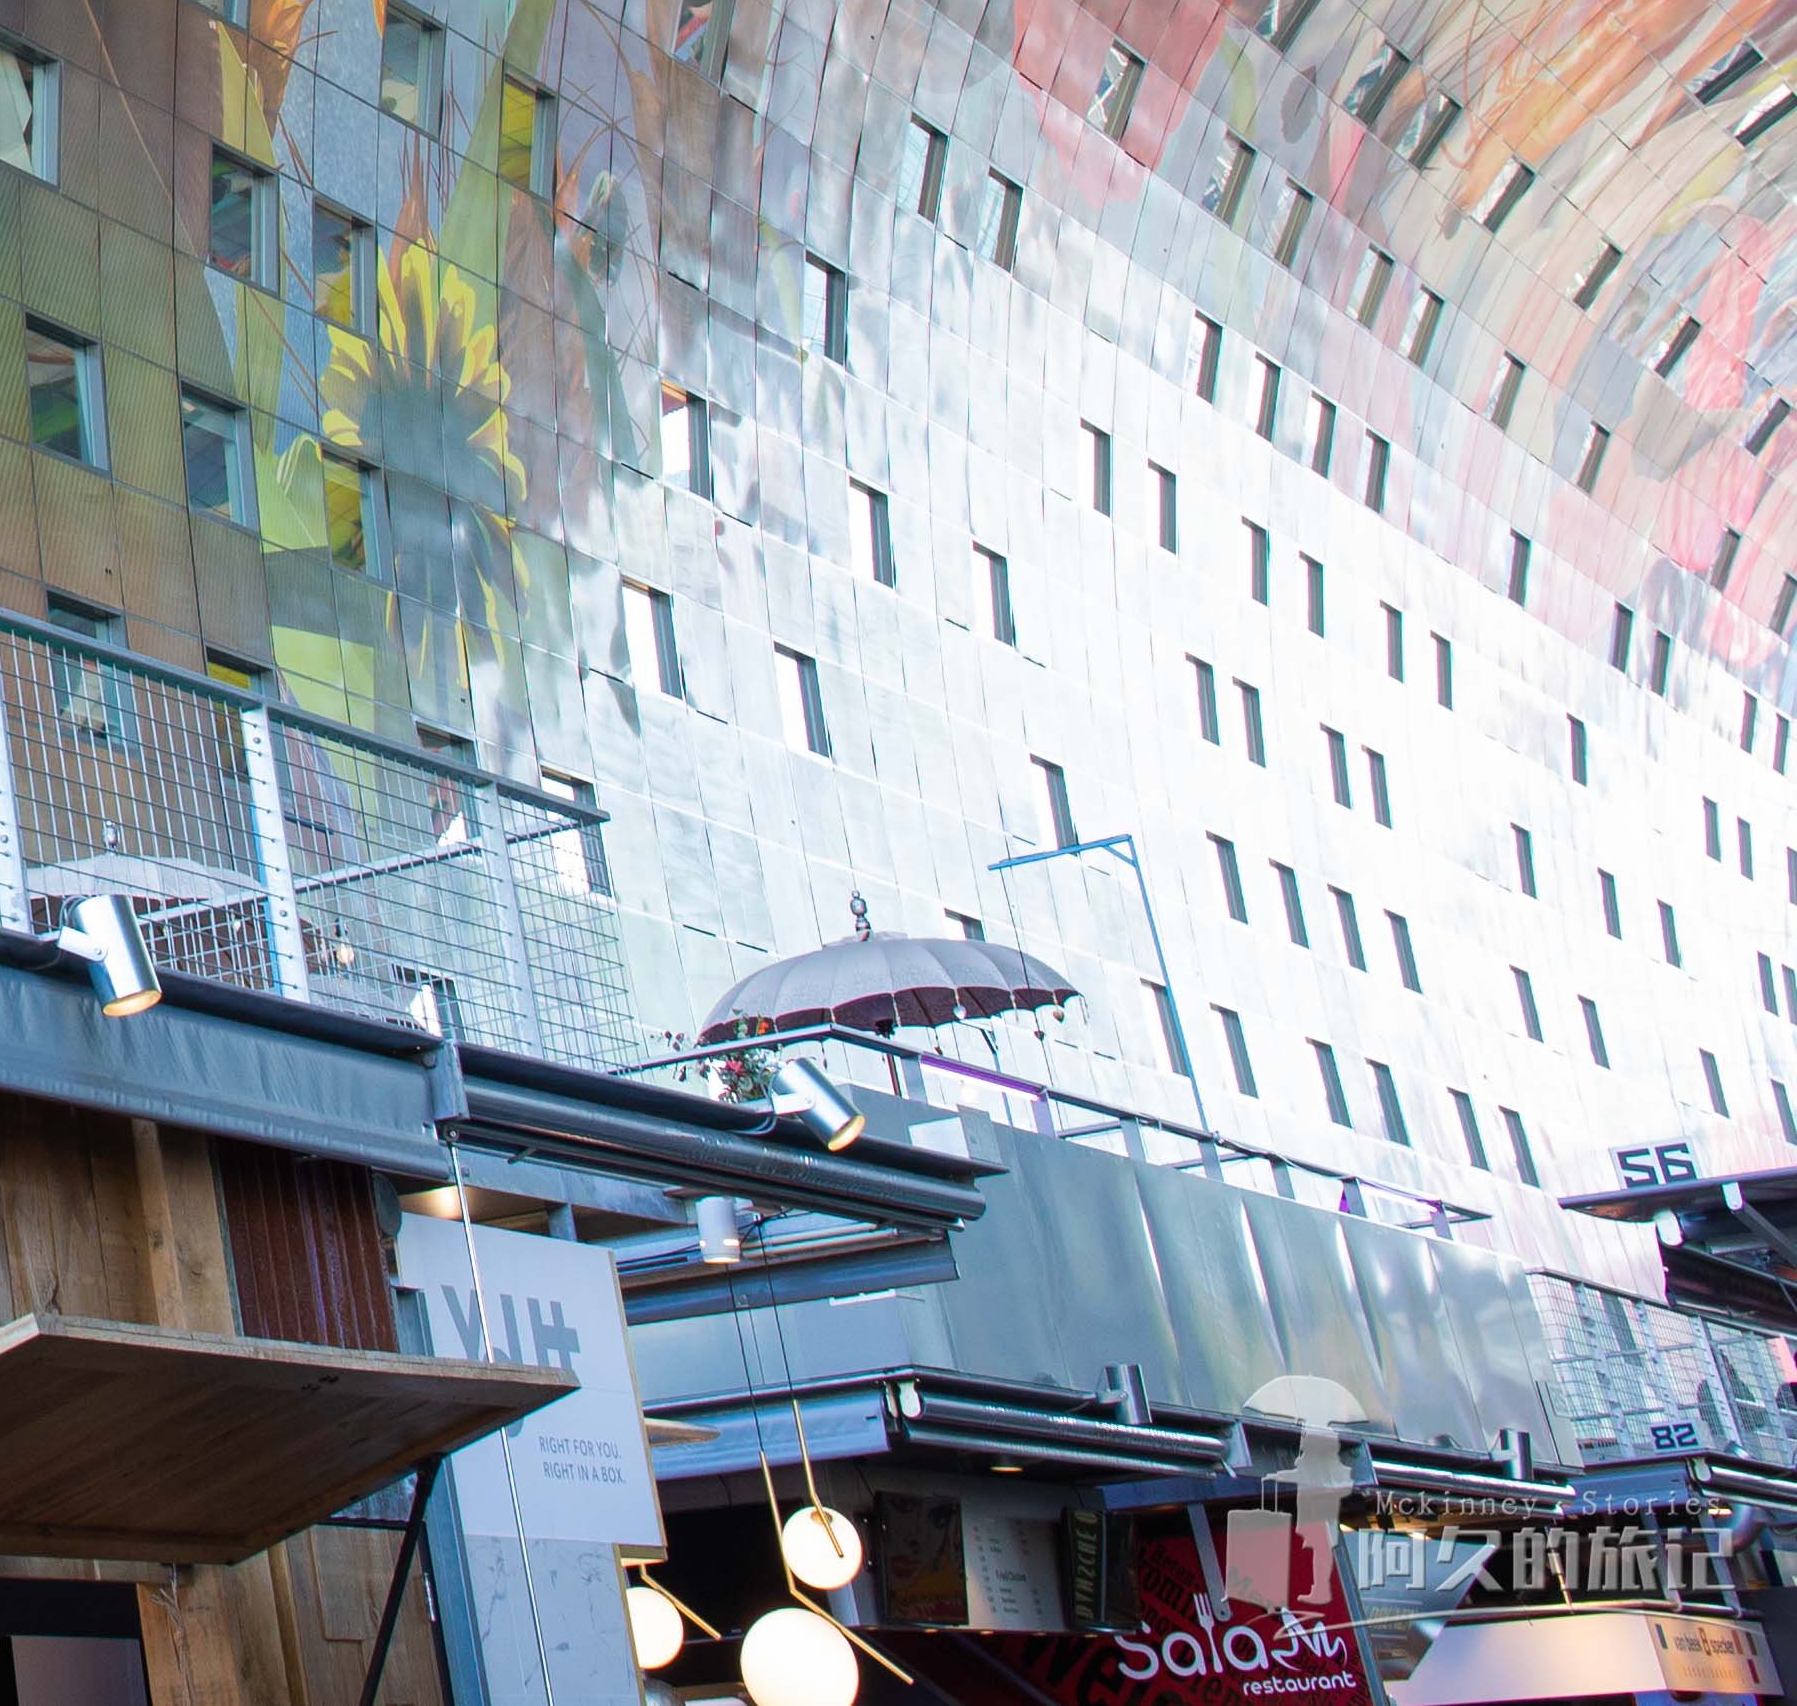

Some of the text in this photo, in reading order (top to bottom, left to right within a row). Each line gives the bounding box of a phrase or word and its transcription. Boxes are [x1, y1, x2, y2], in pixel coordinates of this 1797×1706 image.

[1617, 1143, 1698, 1189] 56
[539, 1436, 622, 1459] RIGHT FOR YOU.
[1651, 1423, 1698, 1450] 82
[543, 1462, 575, 1480] RIGHT
[577, 1466, 590, 1481] IN
[602, 1468, 626, 1484] BOX.
[1243, 1671, 1356, 1696] restaurant
